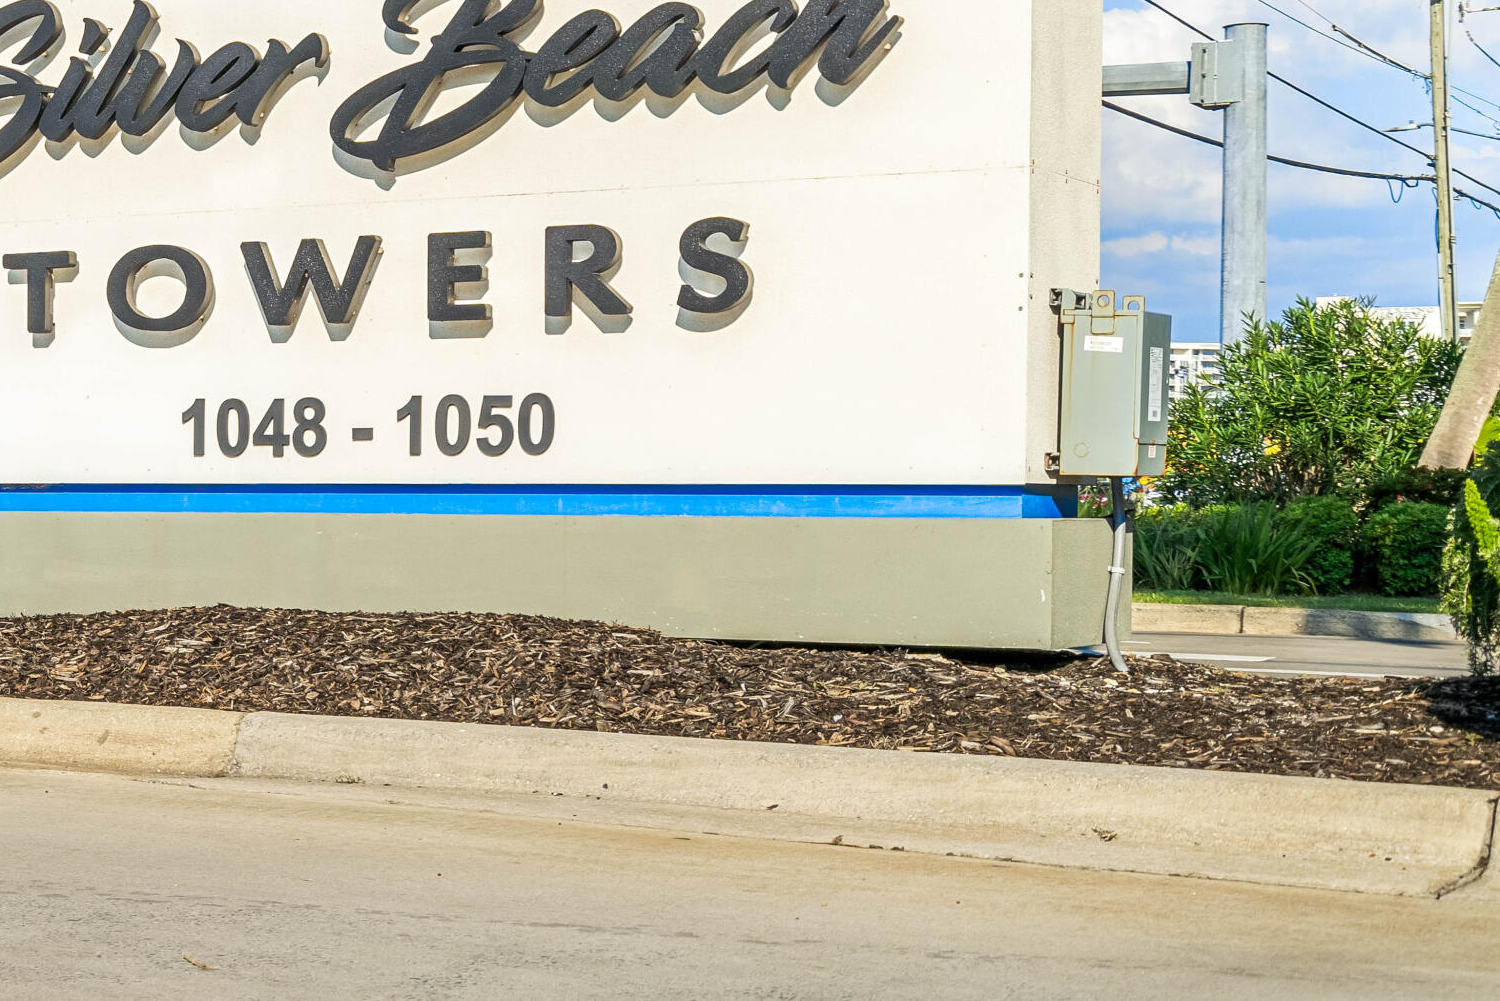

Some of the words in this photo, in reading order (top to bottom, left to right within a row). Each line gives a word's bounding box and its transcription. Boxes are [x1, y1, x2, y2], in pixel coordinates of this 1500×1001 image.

[2, 216, 750, 337] TOWERS
[181, 396, 329, 459] 1048
[351, 427, 375, 443] -
[395, 391, 556, 458] 1050
